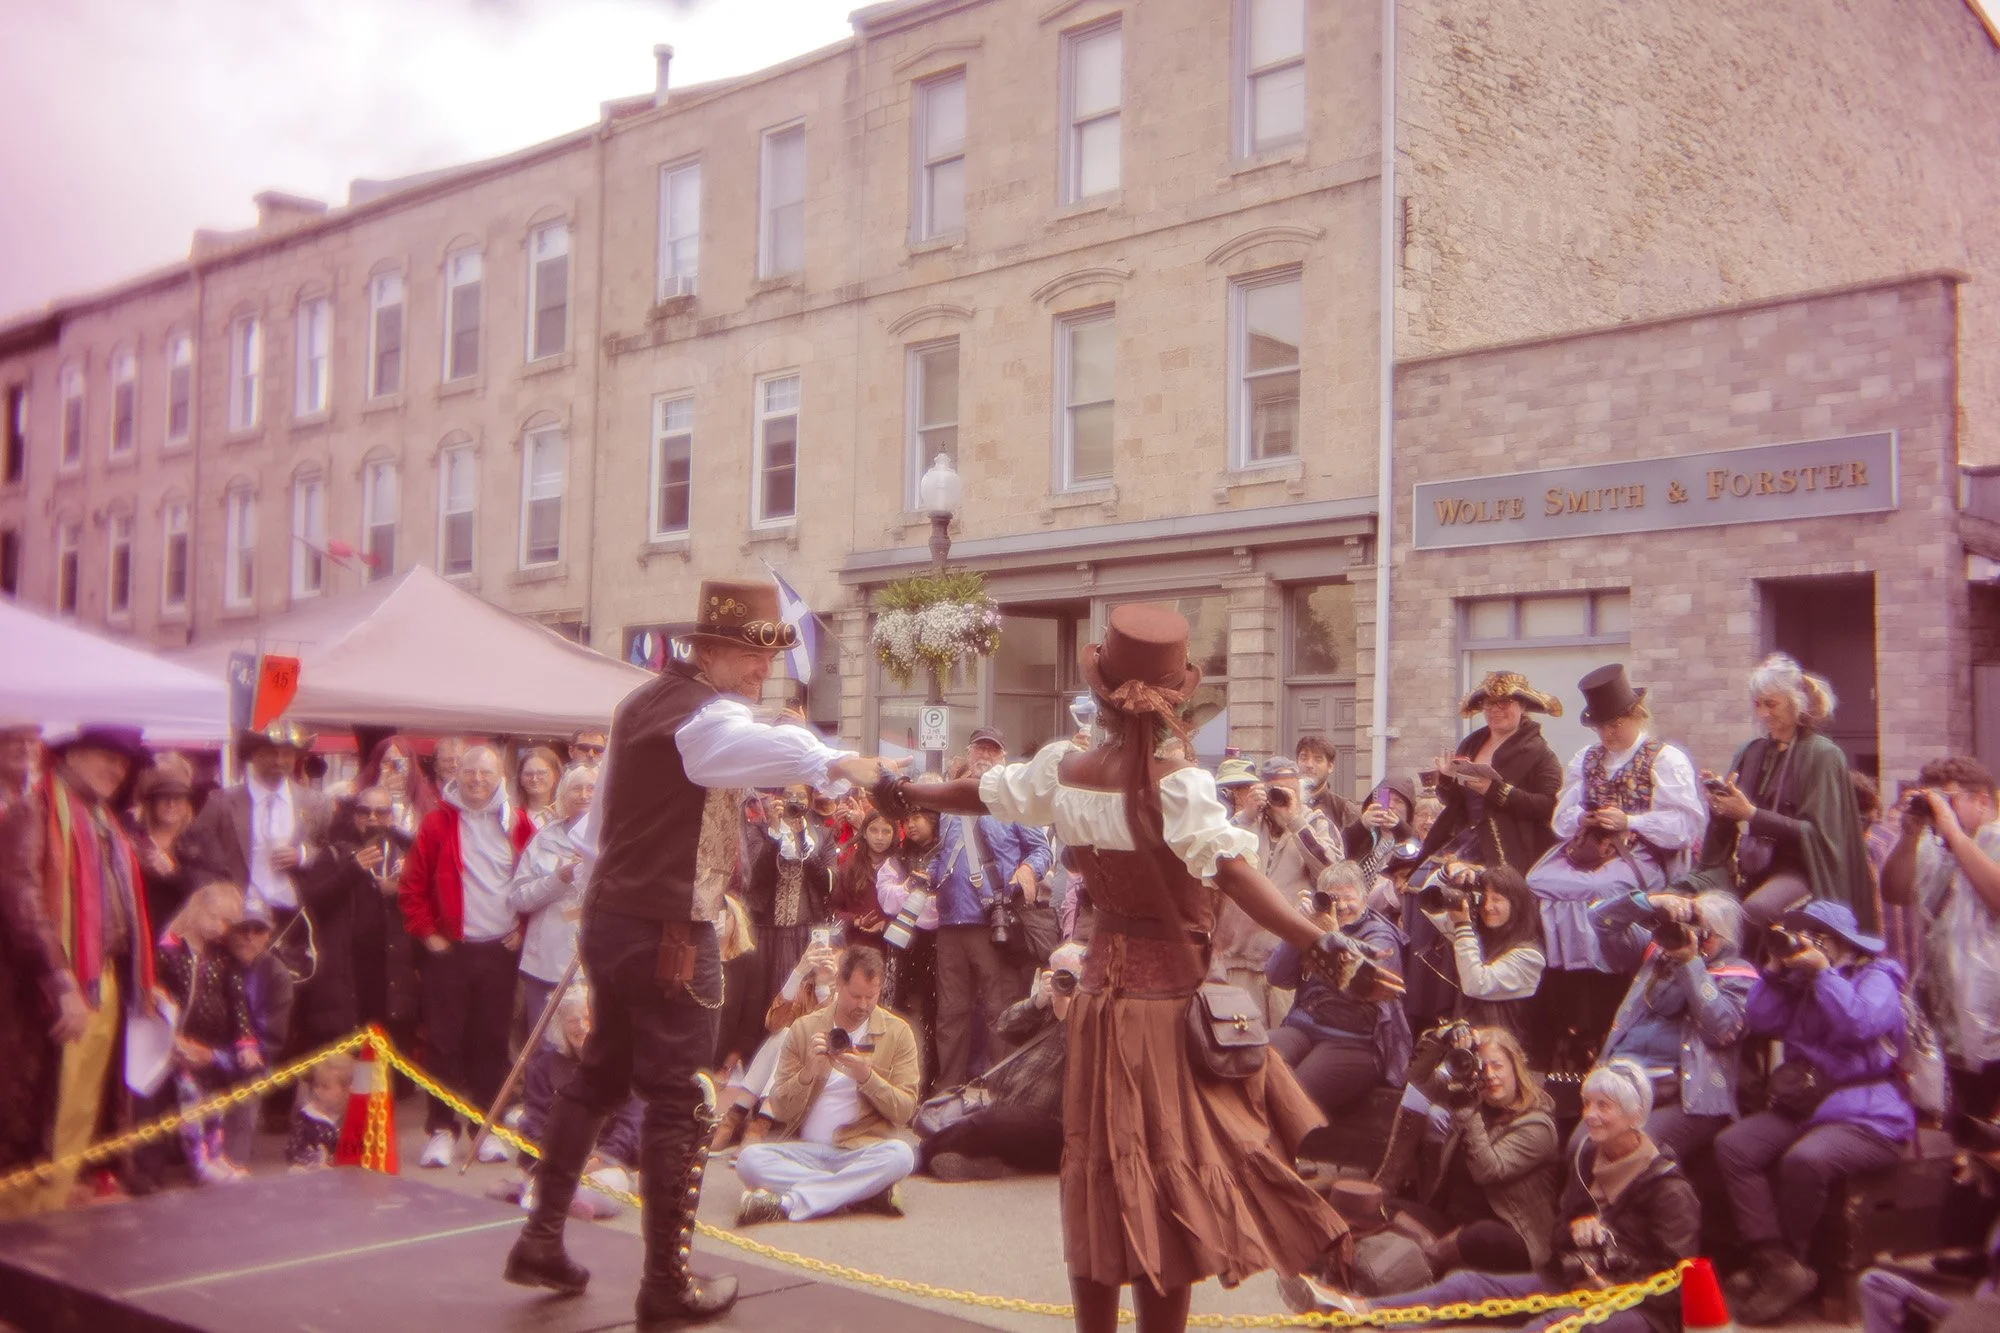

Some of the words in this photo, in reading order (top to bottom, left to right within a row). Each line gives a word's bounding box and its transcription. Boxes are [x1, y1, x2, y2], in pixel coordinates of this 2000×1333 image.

[1434, 496, 1525, 526] WOLFE
[1543, 484, 1645, 517] SMITH
[1665, 479, 1689, 504] &
[1706, 460, 1869, 500] FORSTER
